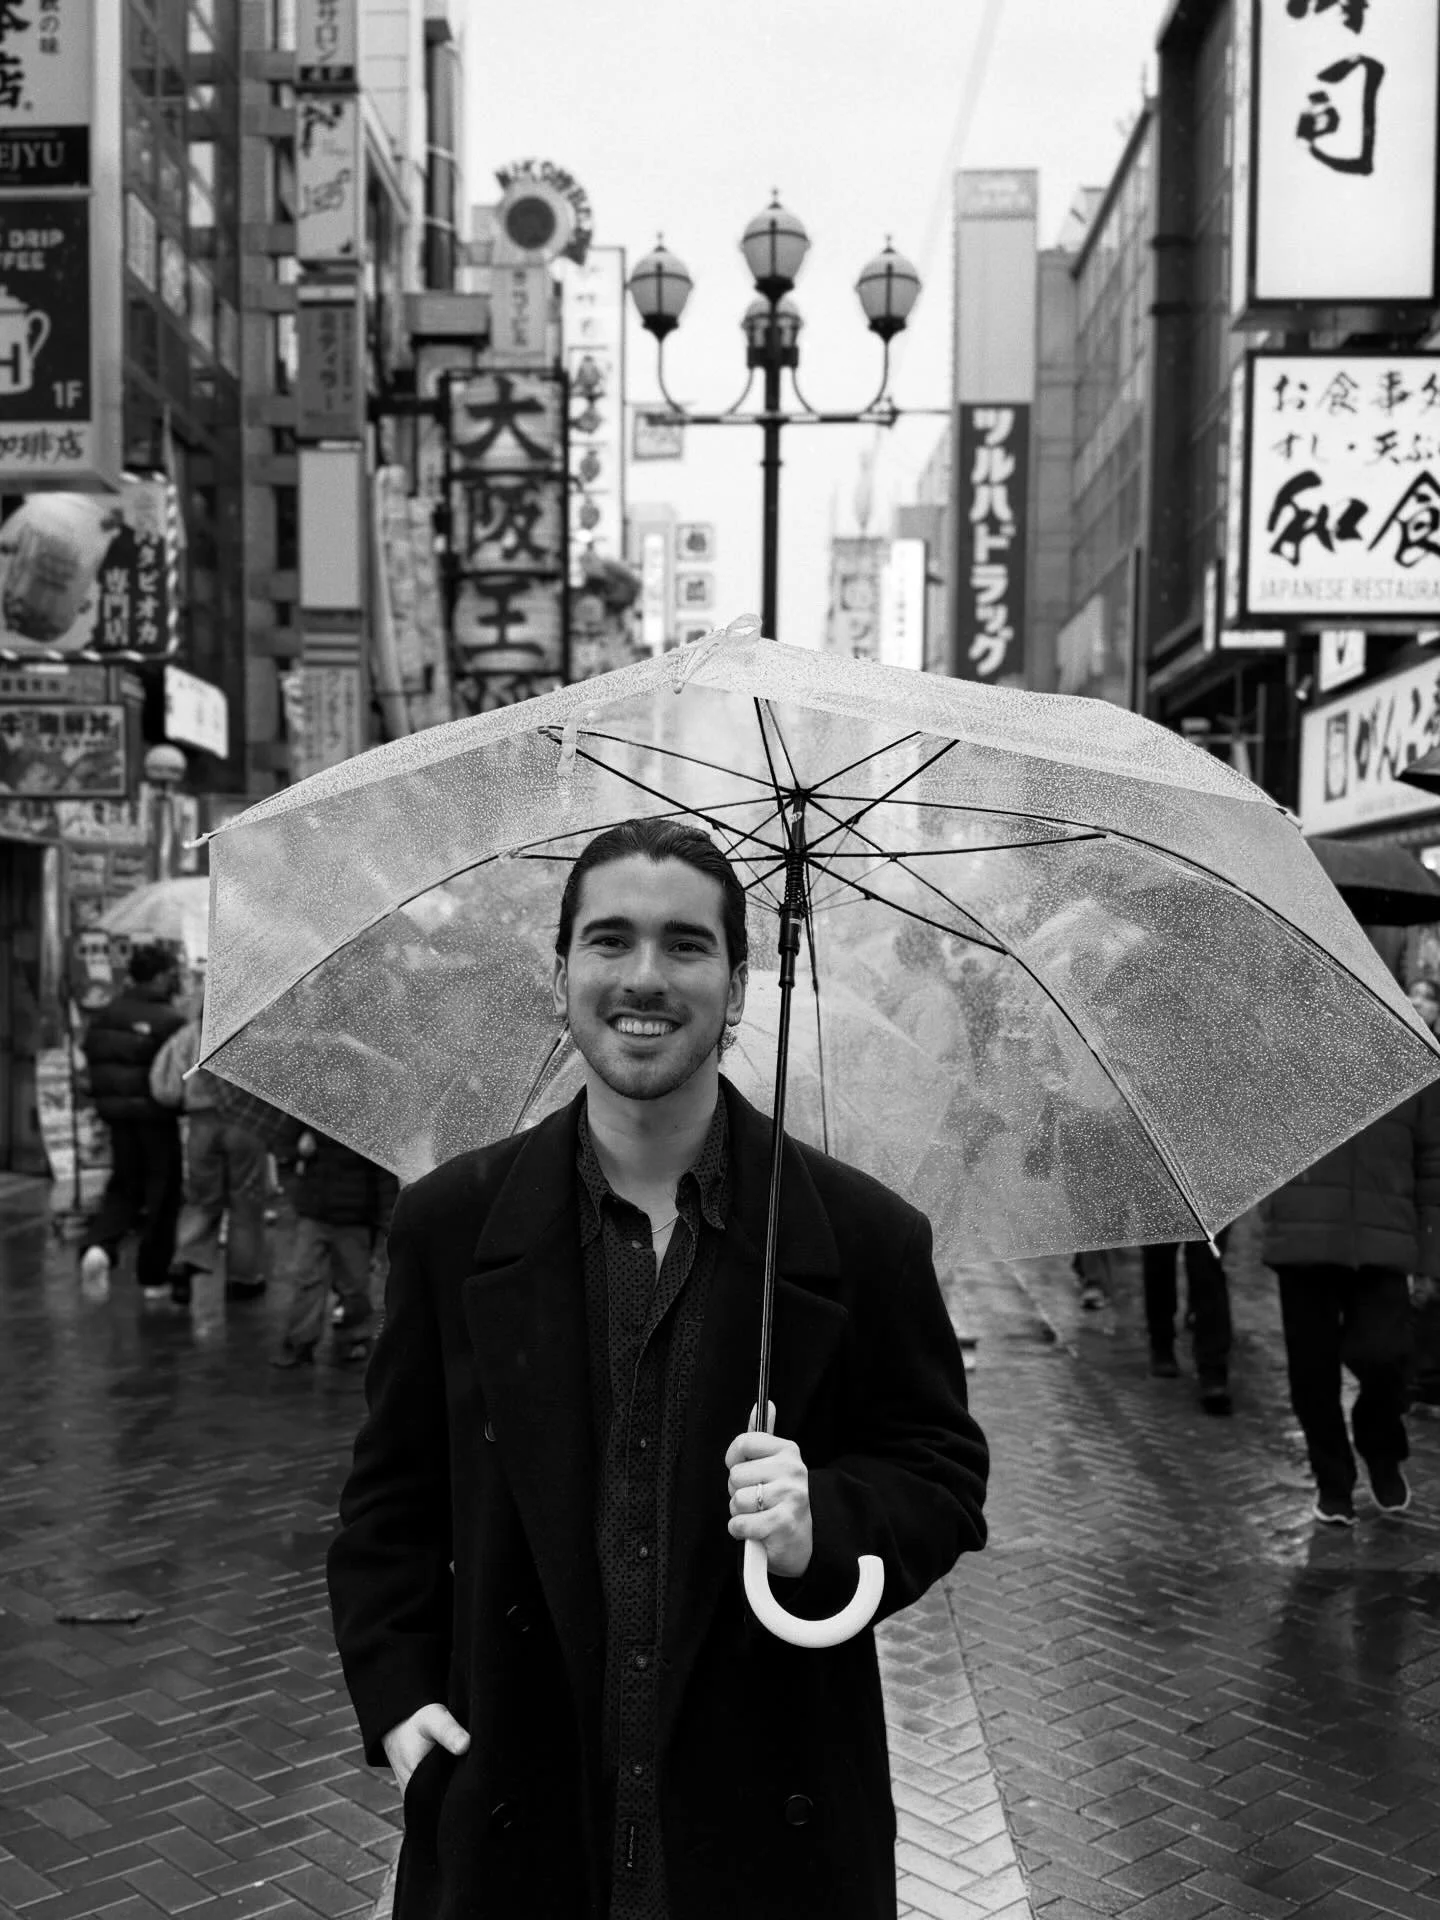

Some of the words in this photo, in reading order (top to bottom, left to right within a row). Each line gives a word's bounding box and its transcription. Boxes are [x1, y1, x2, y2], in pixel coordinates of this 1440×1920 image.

[1286, 0, 1385, 176] 司
[8, 229, 64, 249] DRIP
[0, 251, 45, 271] FEE
[53, 380, 83, 408] 1F
[1270, 428, 1440, 466] すし・天ぷ
[968, 408, 1017, 676] ツルハドラッグ
[1259, 577, 1348, 600] JAPANESE
